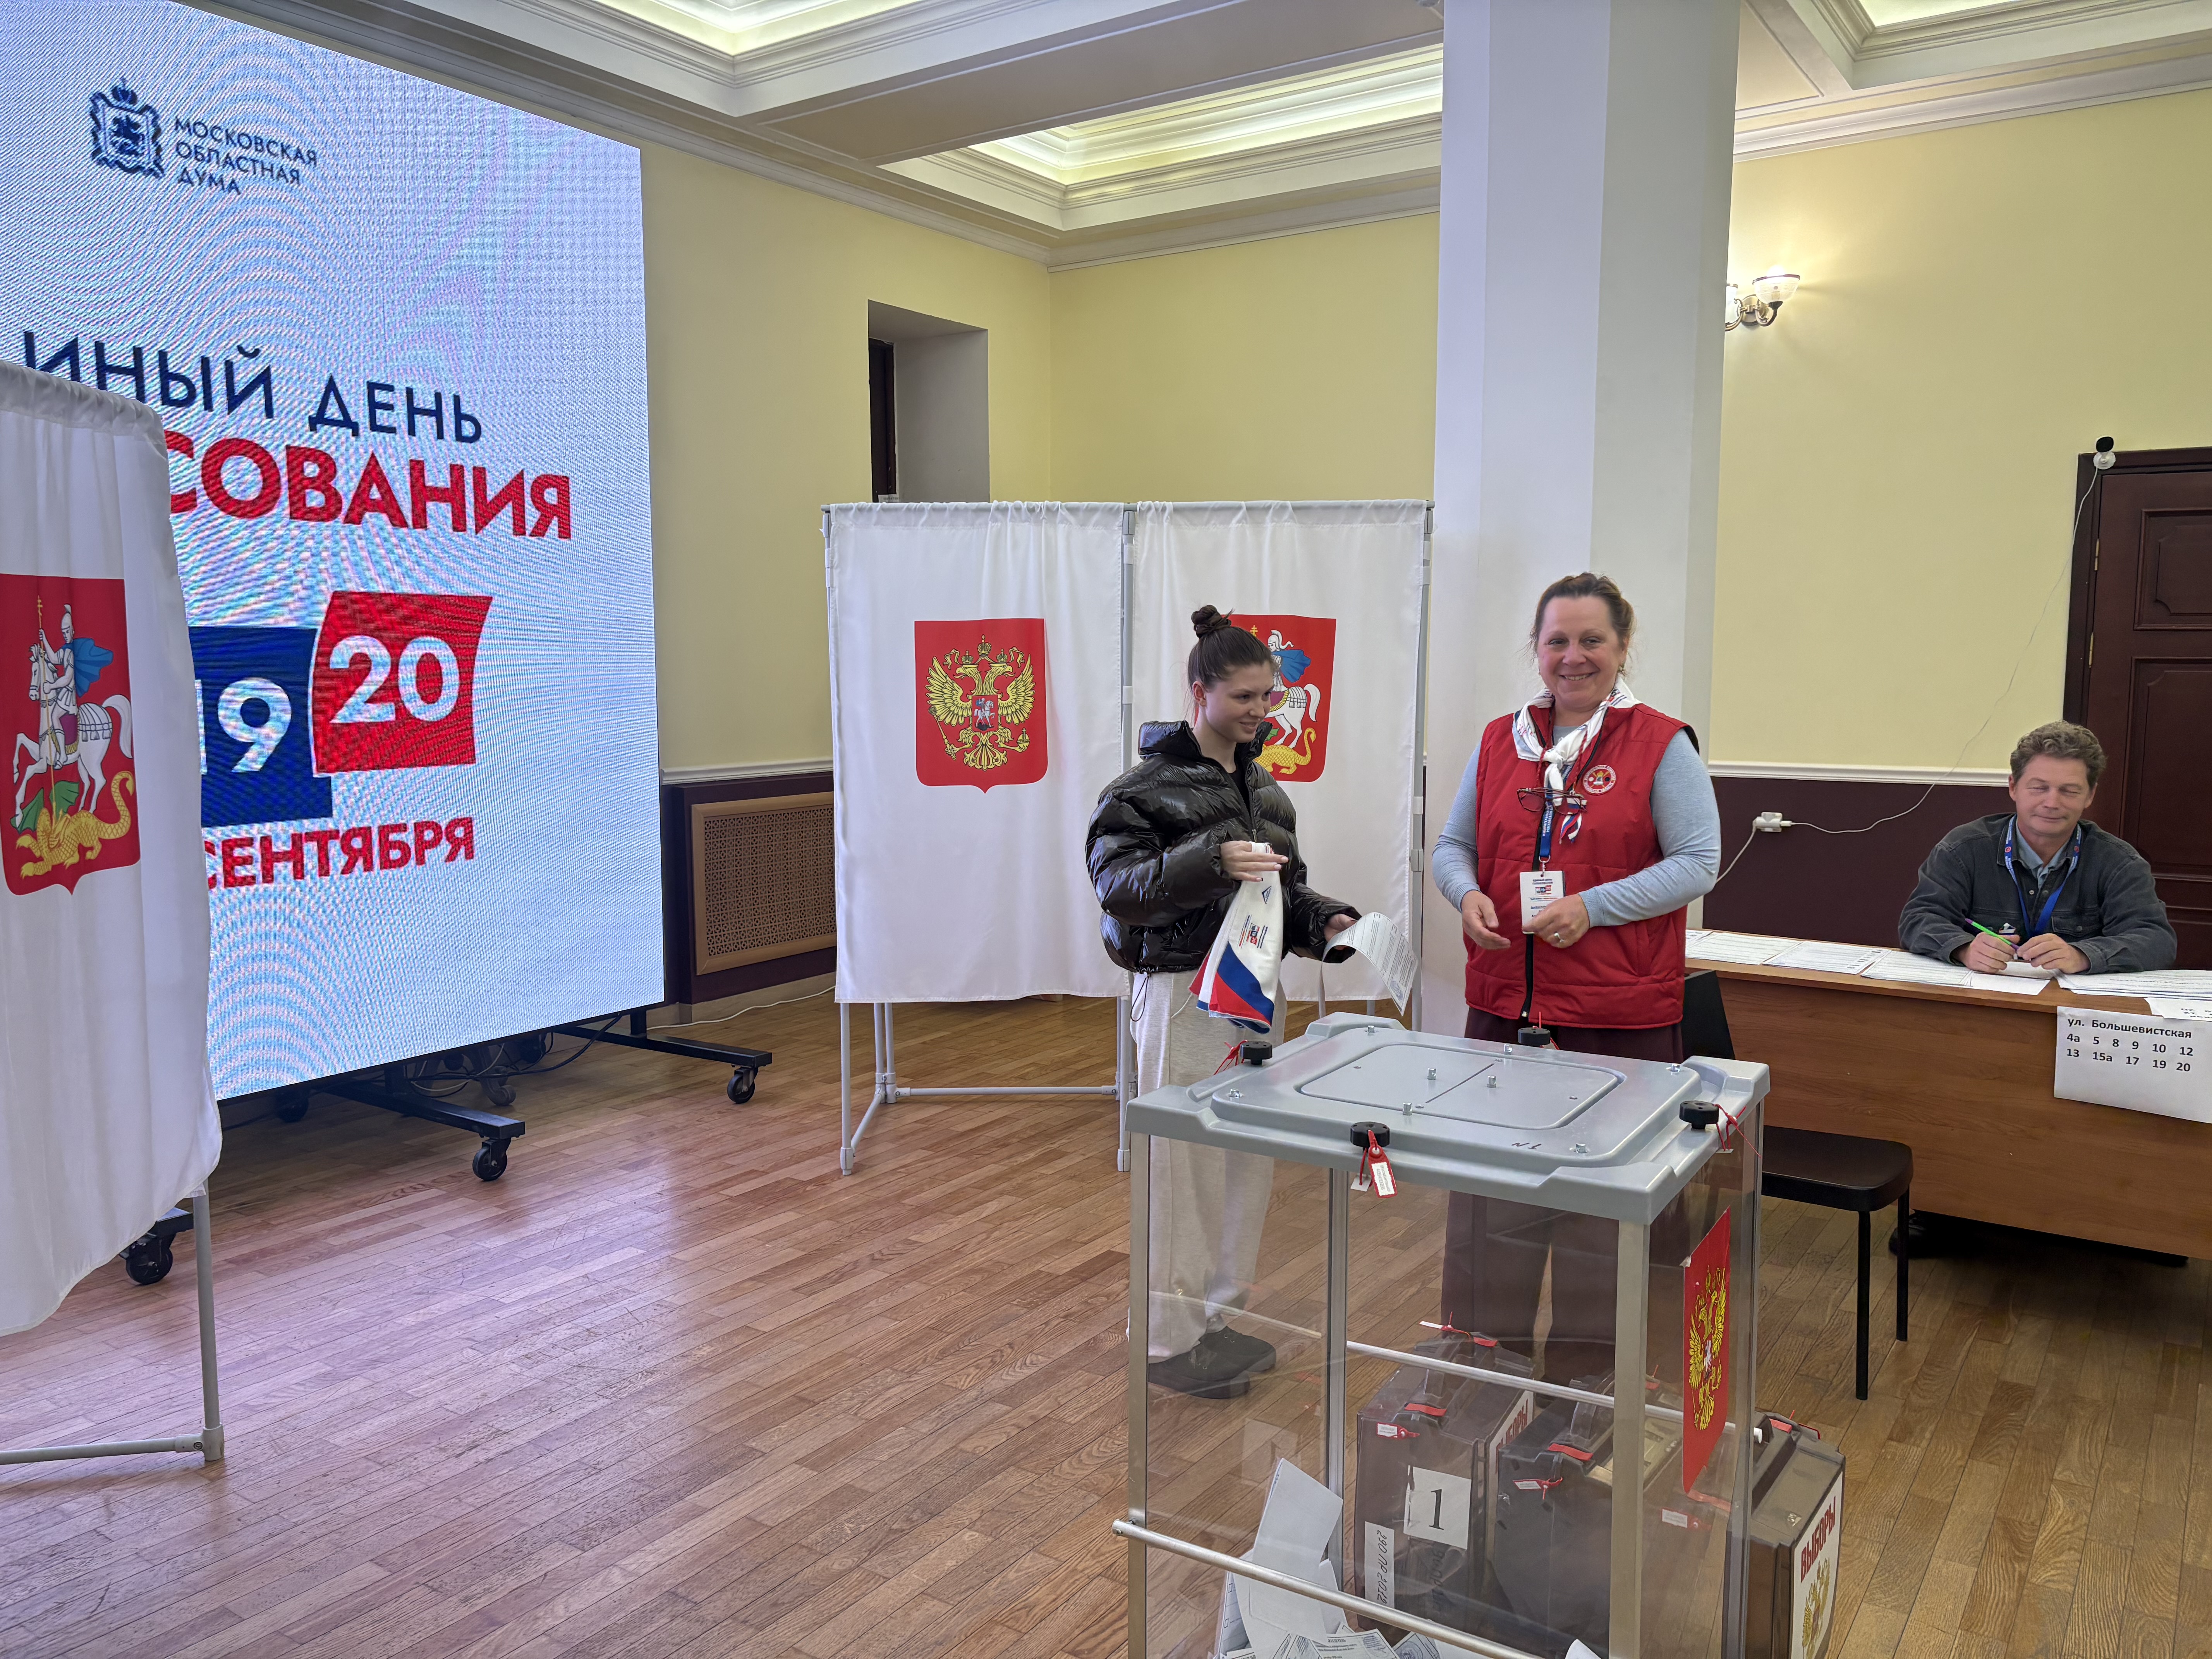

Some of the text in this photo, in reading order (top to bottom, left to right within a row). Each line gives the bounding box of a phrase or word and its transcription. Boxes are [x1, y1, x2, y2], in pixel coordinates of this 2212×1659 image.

[175, 117, 317, 167] МОСКОВСКАЯ
[176, 142, 300, 185] ОБЛАСТНАЯ
[178, 167, 241, 194] ДУМА
[309, 376, 482, 444] ДЕНЬ
[329, 635, 460, 725] 20
[2066, 1034, 2193, 1056] 4а 5 8 9 10 12
[2068, 1018, 2191, 1038] ул. Большевистская
[2066, 1048, 2191, 1072] 13 15а 17 19 20
[1428, 1489, 1444, 1530] 1
[1801, 1496, 1836, 1583] ВЫБОРЫ
